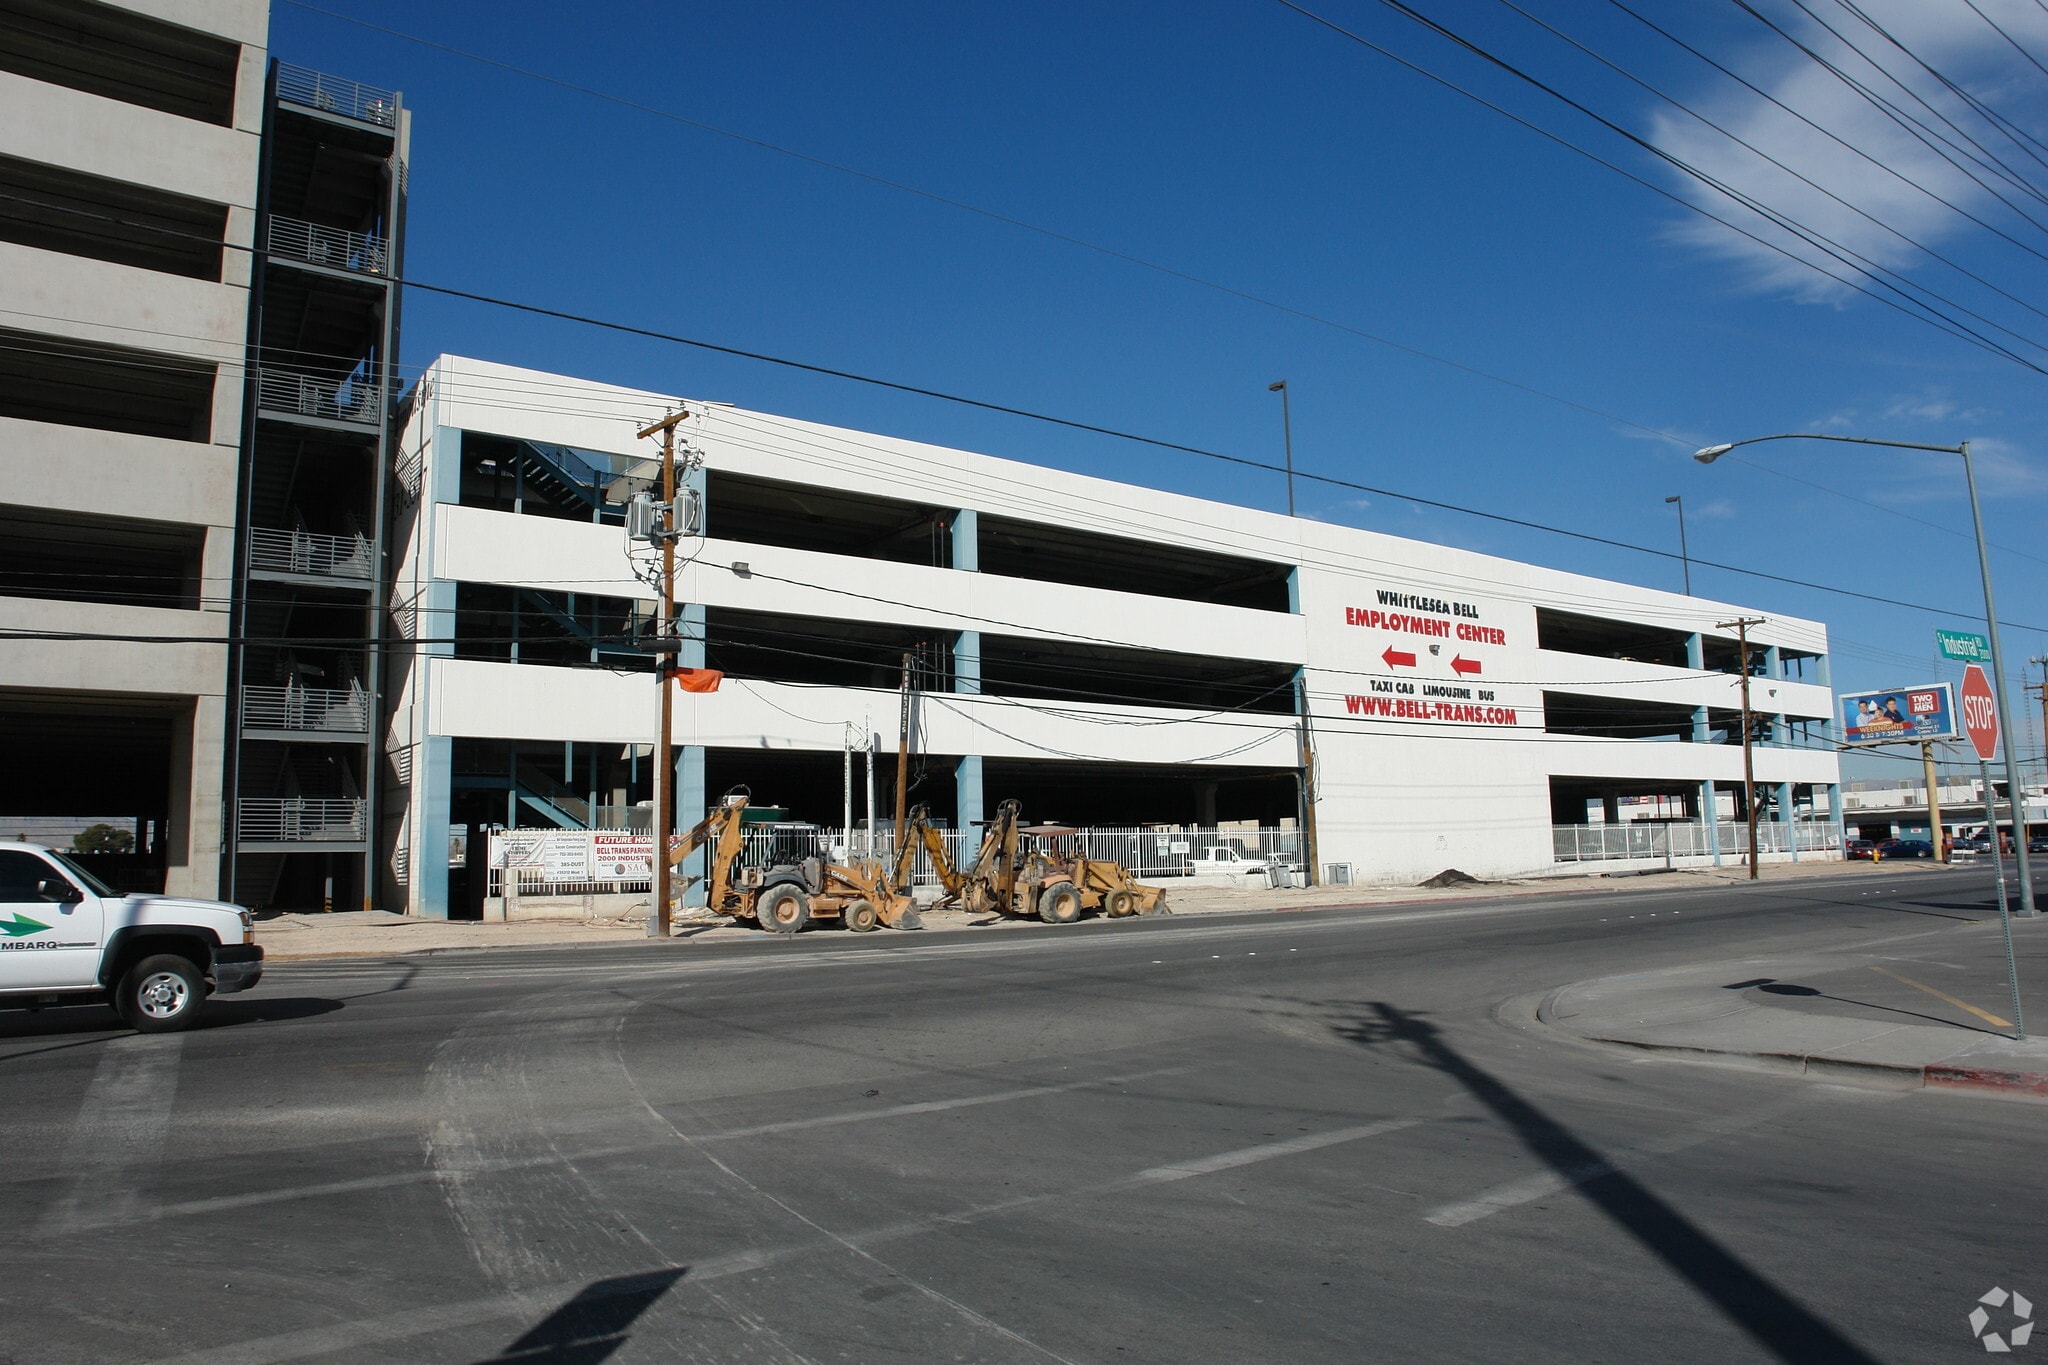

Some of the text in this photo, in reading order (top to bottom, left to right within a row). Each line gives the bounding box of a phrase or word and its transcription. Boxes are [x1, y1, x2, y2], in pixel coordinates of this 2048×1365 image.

[1376, 589, 1479, 619] WHITTLESEA BELL
[1345, 606, 1506, 646] EMPLOYMENT CENTER
[1942, 634, 1978, 656] Industrial
[1370, 680, 1495, 701] TAXI CAB LIMOUSINE BUS
[1912, 694, 1933, 703] TWO
[1345, 694, 1517, 725] WWW.BELL-TRANS.COM
[1914, 703, 1934, 713] MEN
[1964, 695, 1994, 730] STOP
[1859, 723, 1904, 734] WEEKNIGHTS
[598, 836, 653, 844] FUTURE HOM
[0, 941, 58, 951] MBARQ
